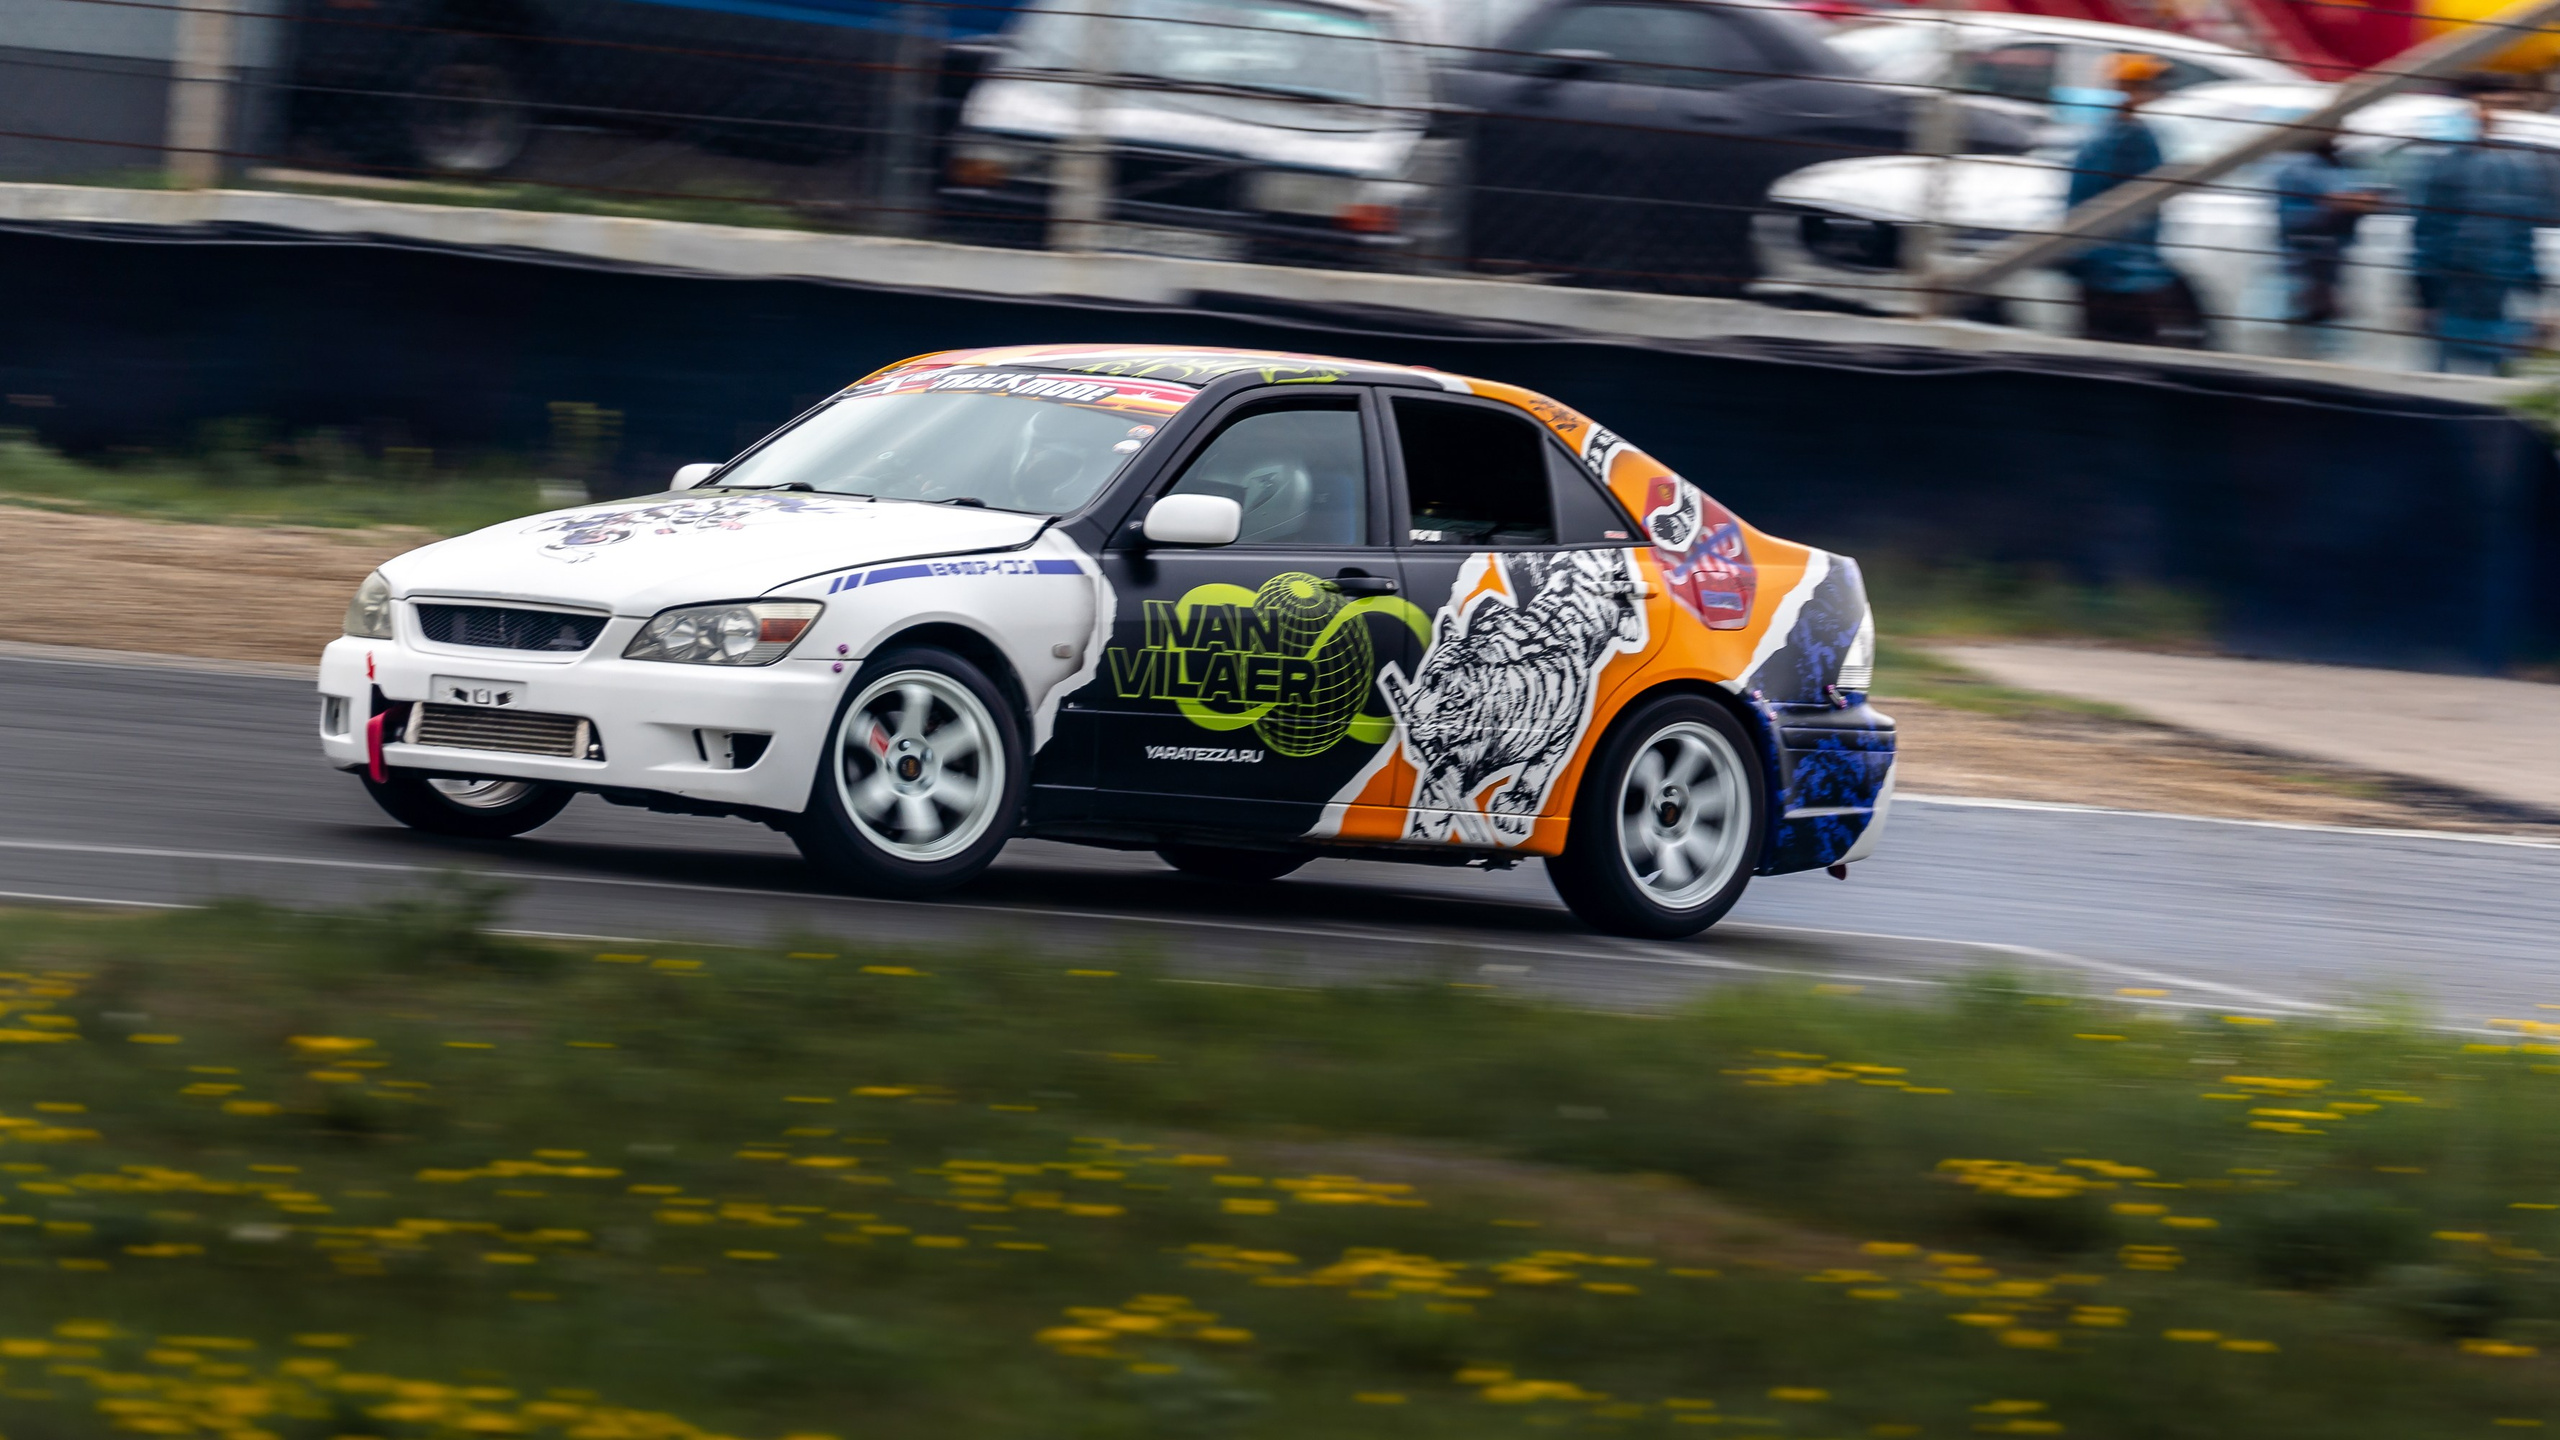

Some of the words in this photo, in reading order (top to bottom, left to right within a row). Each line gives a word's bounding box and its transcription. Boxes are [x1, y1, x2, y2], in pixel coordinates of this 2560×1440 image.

[1142, 599, 1283, 655] IVAN
[1107, 647, 1319, 707] VILAER
[1145, 746, 1264, 763] YARATEZZA.RU
